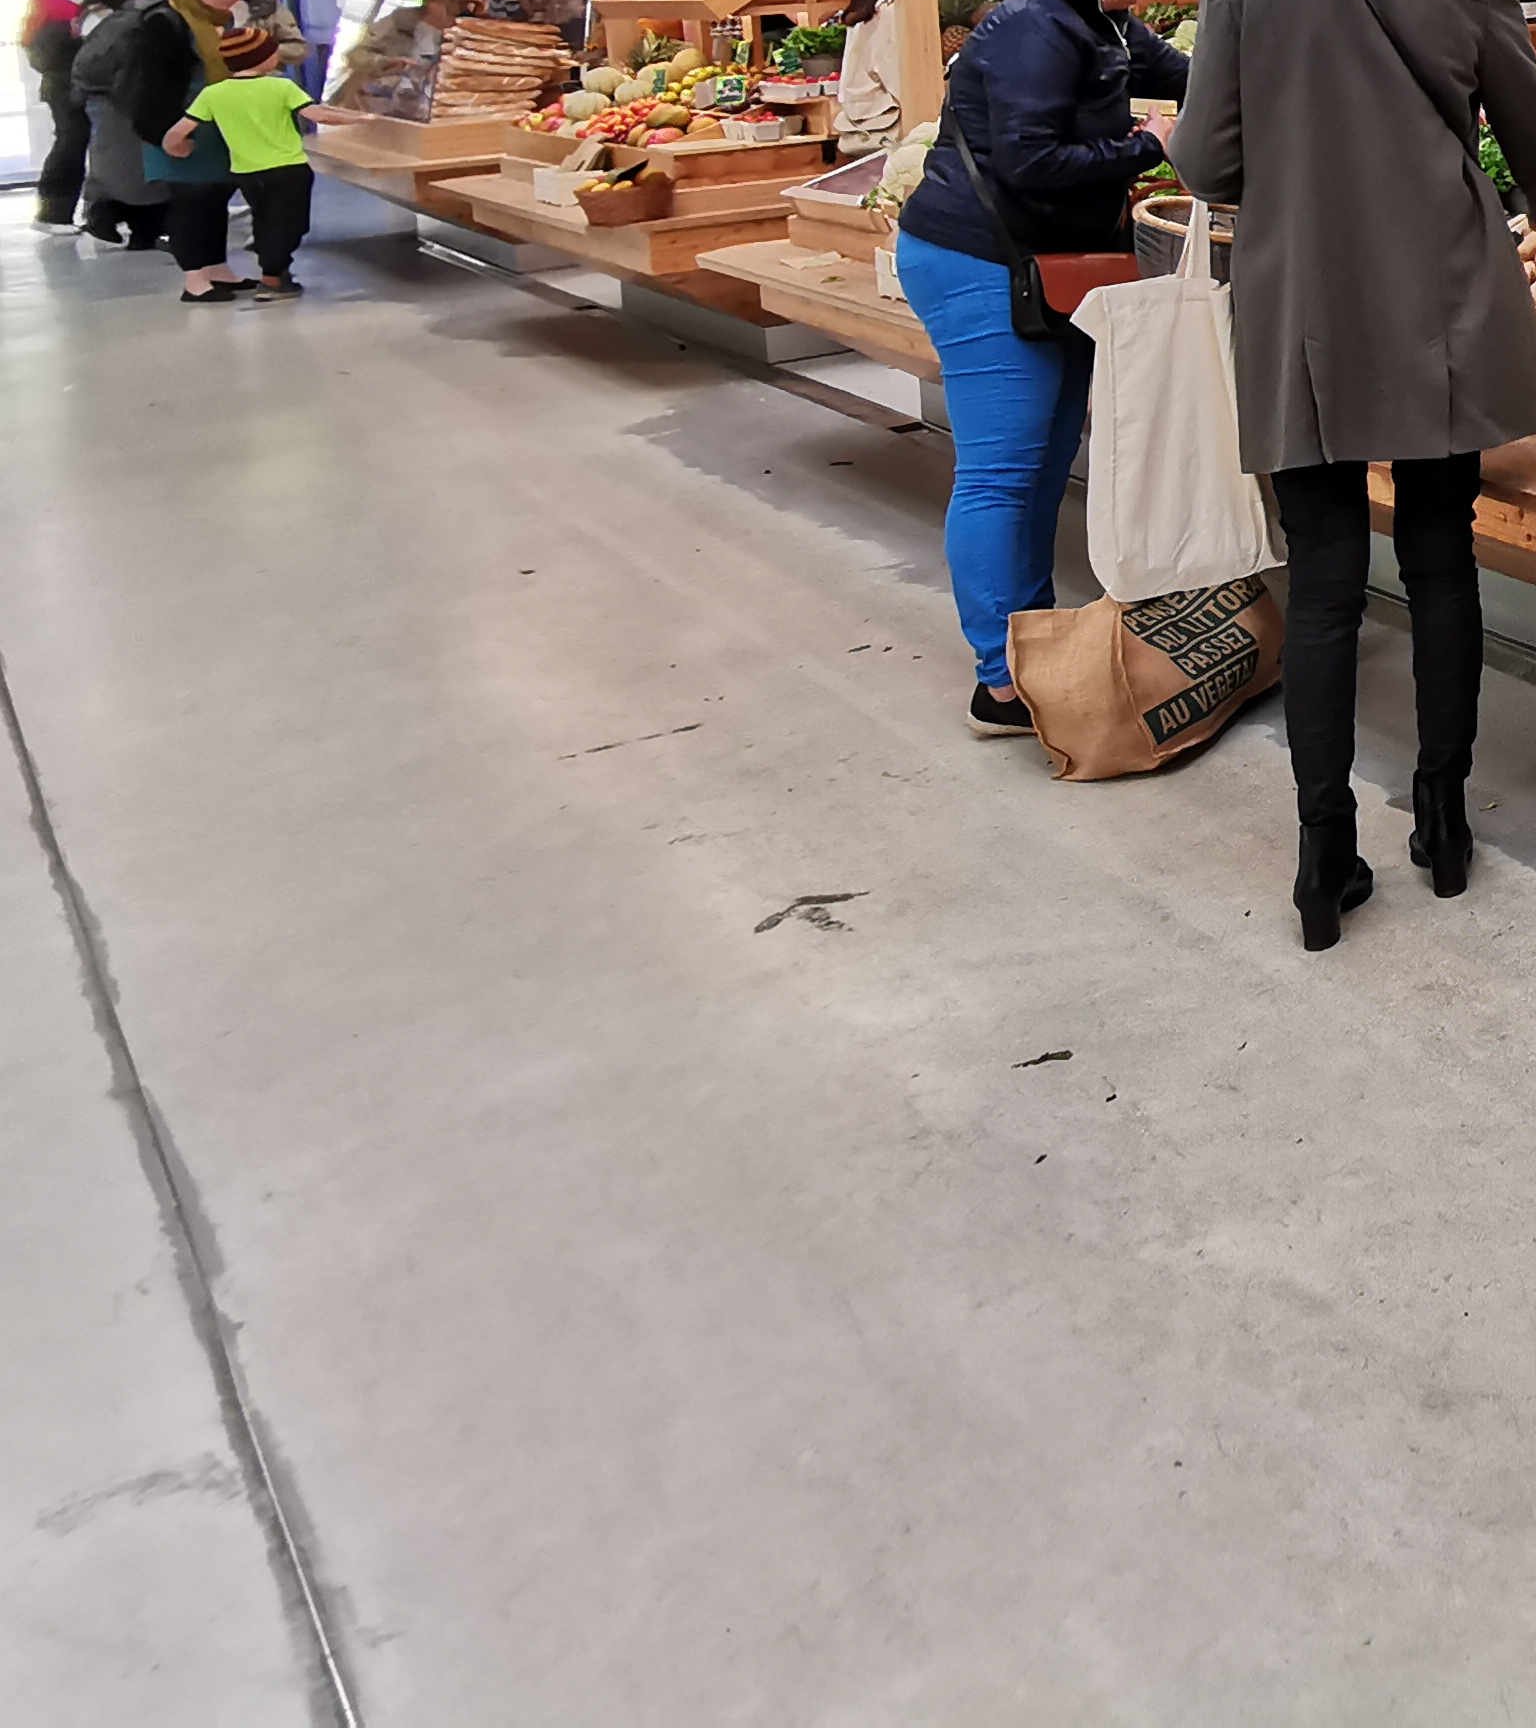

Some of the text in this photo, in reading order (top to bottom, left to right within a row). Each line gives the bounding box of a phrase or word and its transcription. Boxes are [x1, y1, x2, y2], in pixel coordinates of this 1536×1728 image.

[1152, 626, 1188, 651] AU
[1177, 626, 1251, 674] PASSEZ
[1158, 697, 1192, 736] AU
